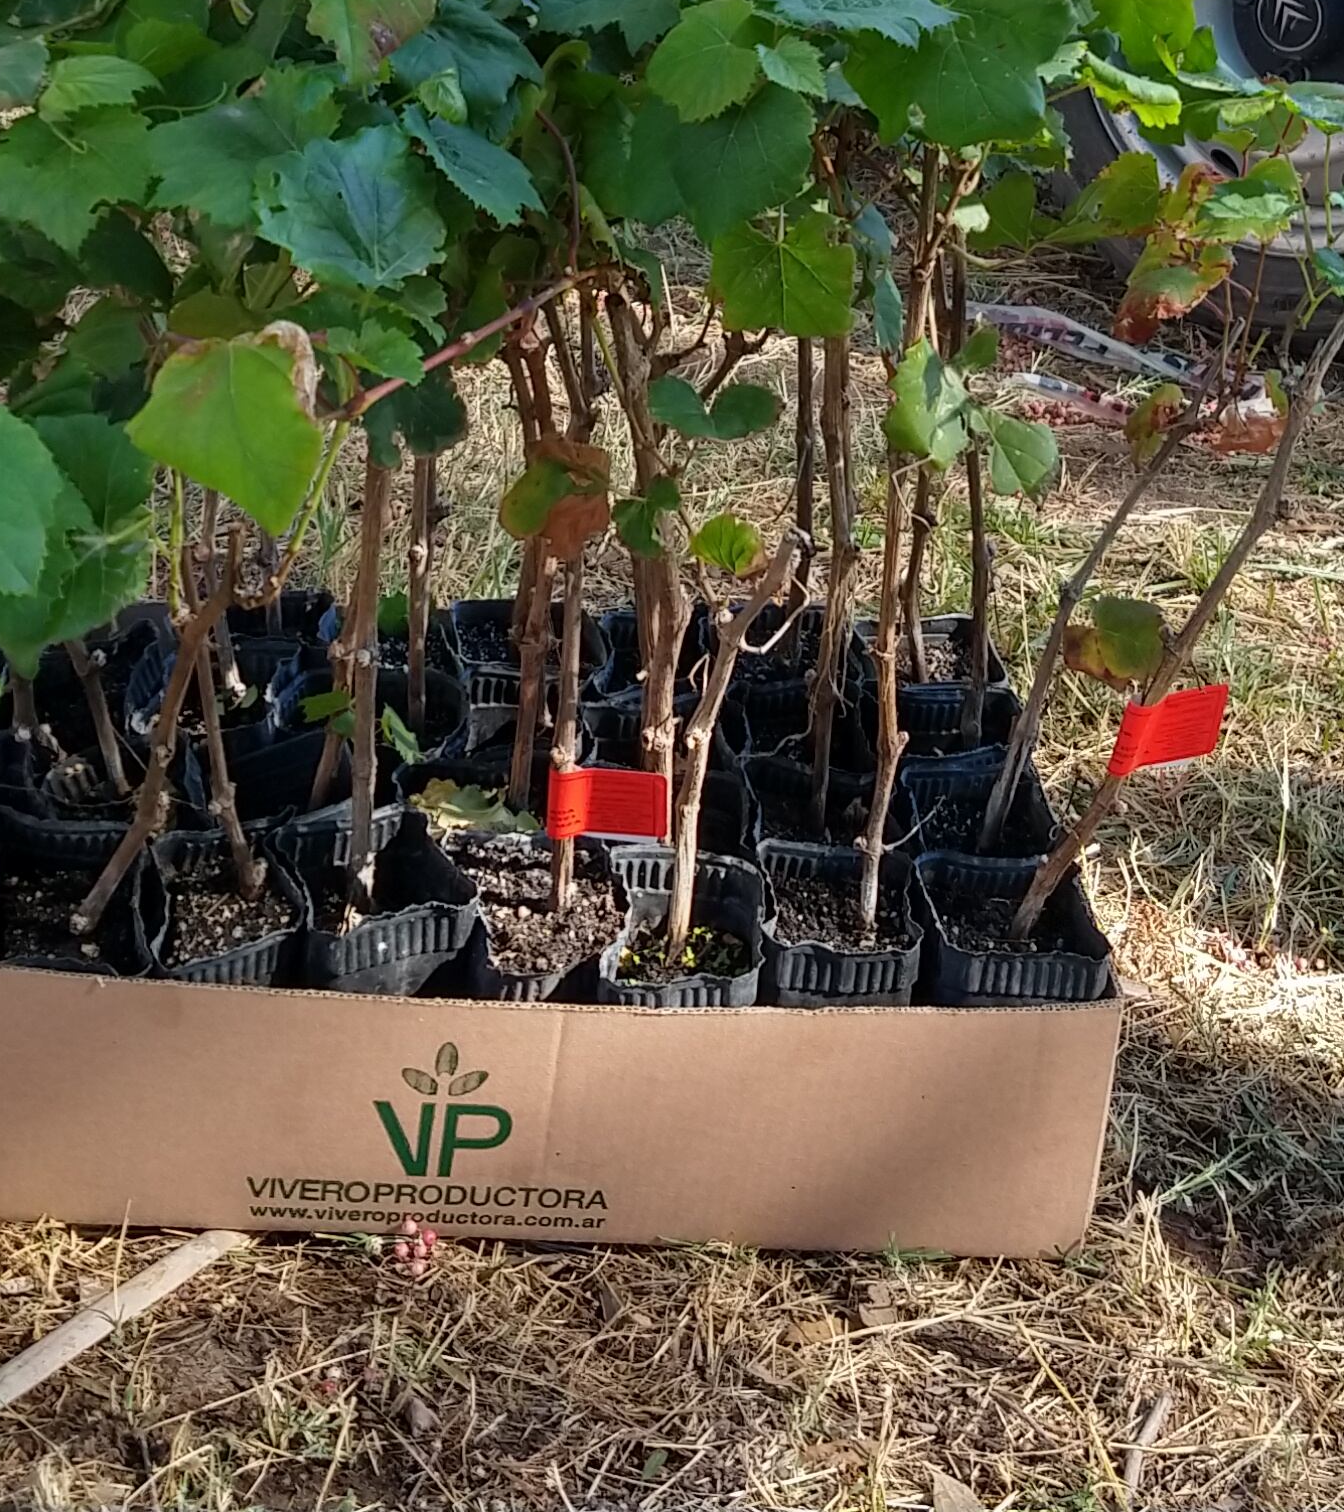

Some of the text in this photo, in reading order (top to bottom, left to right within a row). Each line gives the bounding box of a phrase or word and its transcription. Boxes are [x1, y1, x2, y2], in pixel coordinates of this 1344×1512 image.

[372, 1099, 513, 1178] VP
[246, 1175, 608, 1210] VIVEROPRODUCTORA
[249, 1205, 606, 1229] www.viveroproductora.com.ar
